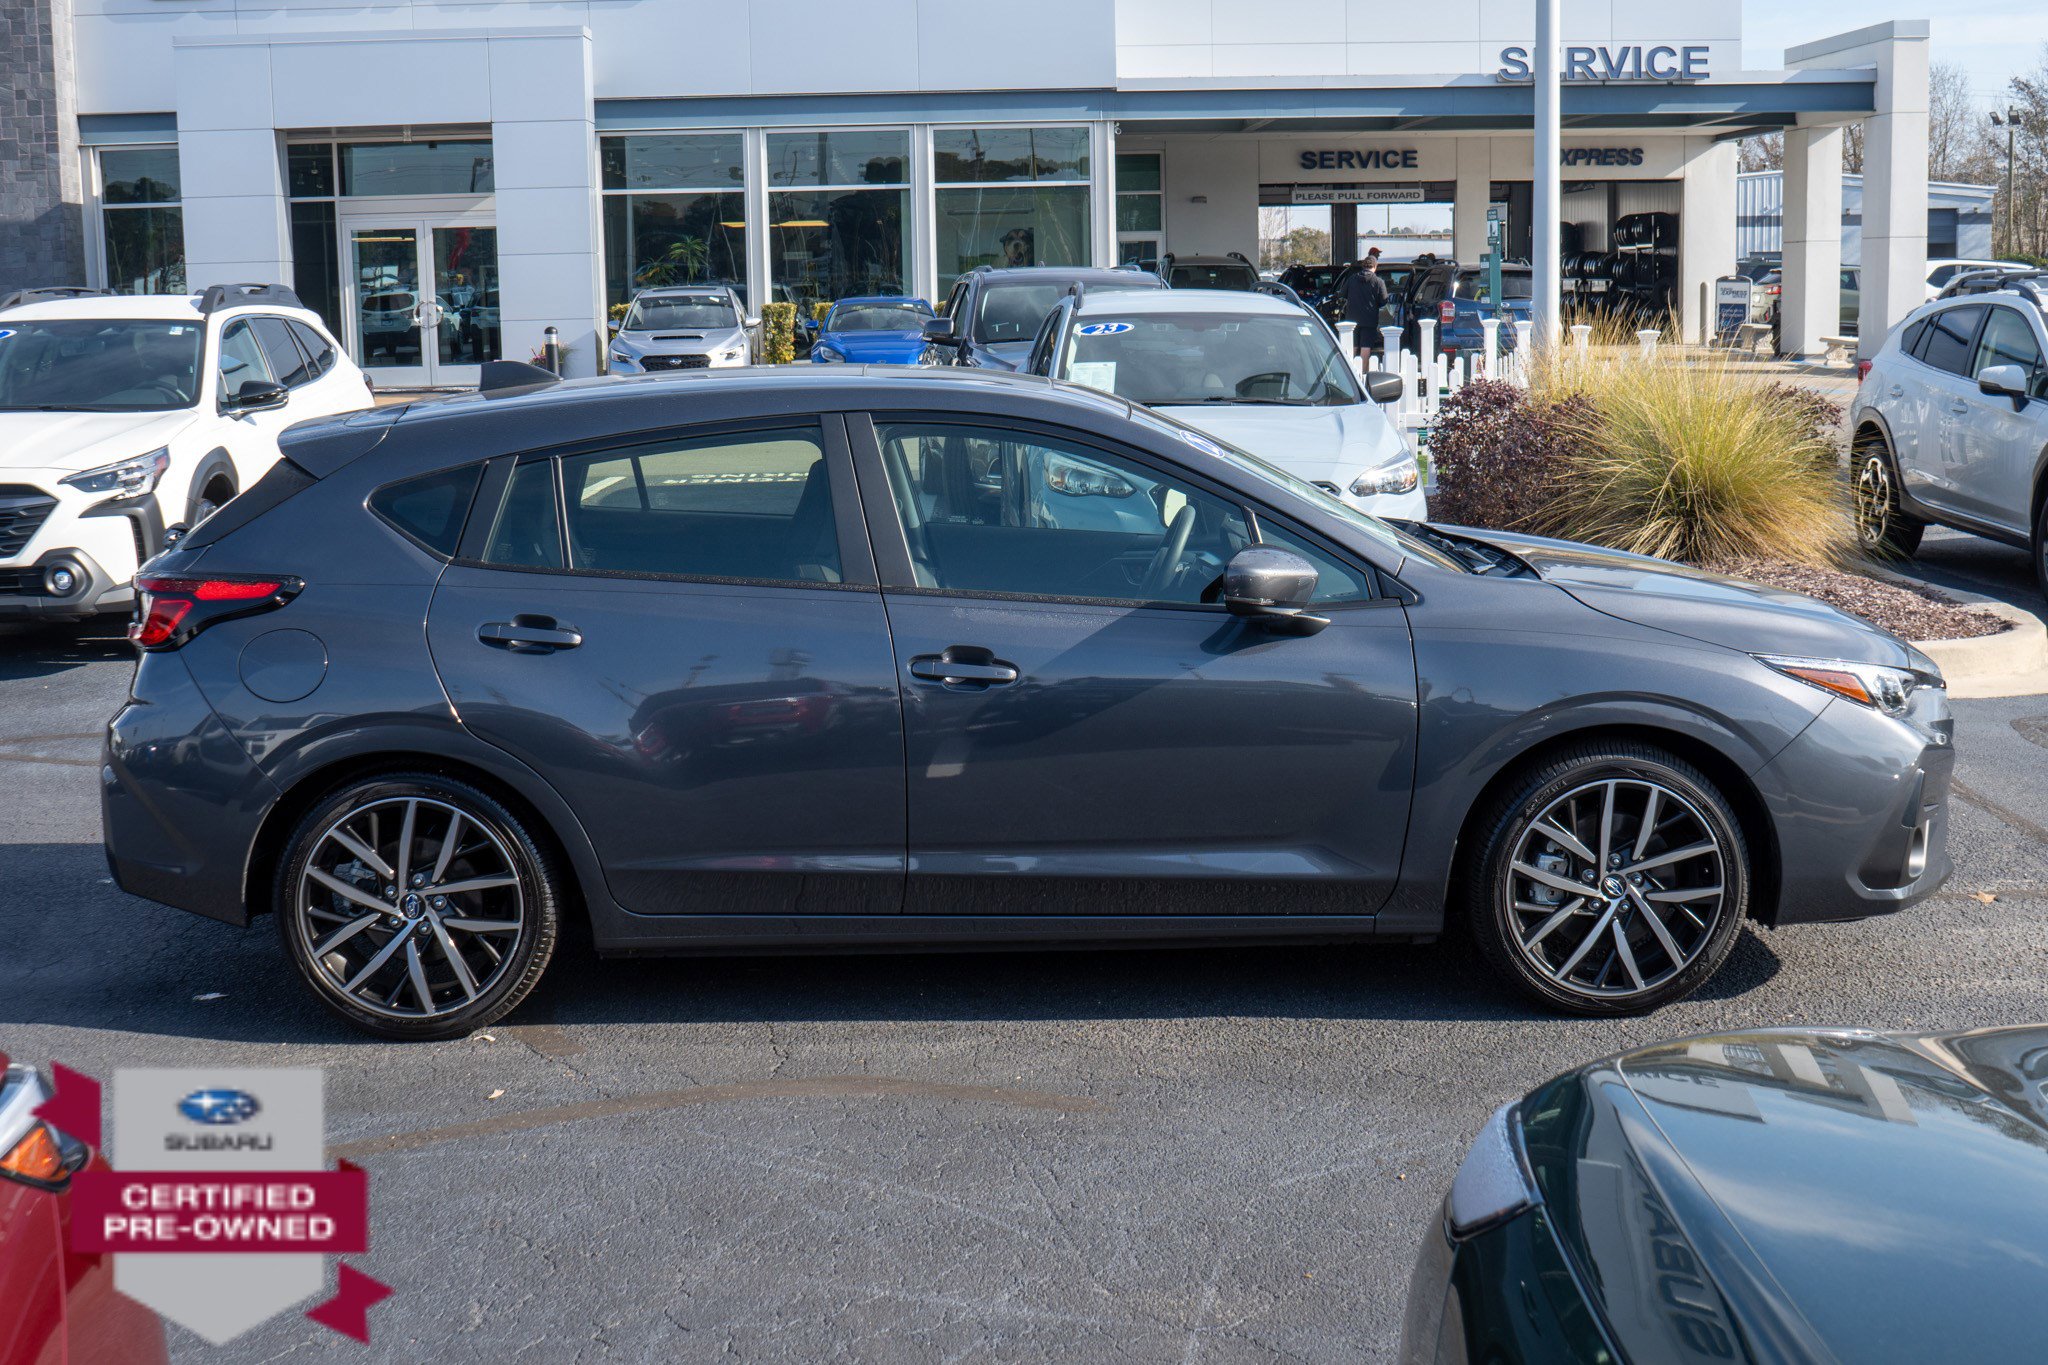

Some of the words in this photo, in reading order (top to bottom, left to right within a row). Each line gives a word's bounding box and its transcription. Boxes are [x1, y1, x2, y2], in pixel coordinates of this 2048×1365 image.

[1499, 45, 1710, 80] SRVICE
[1300, 149, 1418, 170] SERVICE
[1560, 147, 1644, 166] XPRESS
[1295, 192, 1335, 201] PLEASE
[1338, 192, 1363, 200] PULL
[1367, 191, 1420, 200] FORWARD
[1091, 322, 1118, 334] 23
